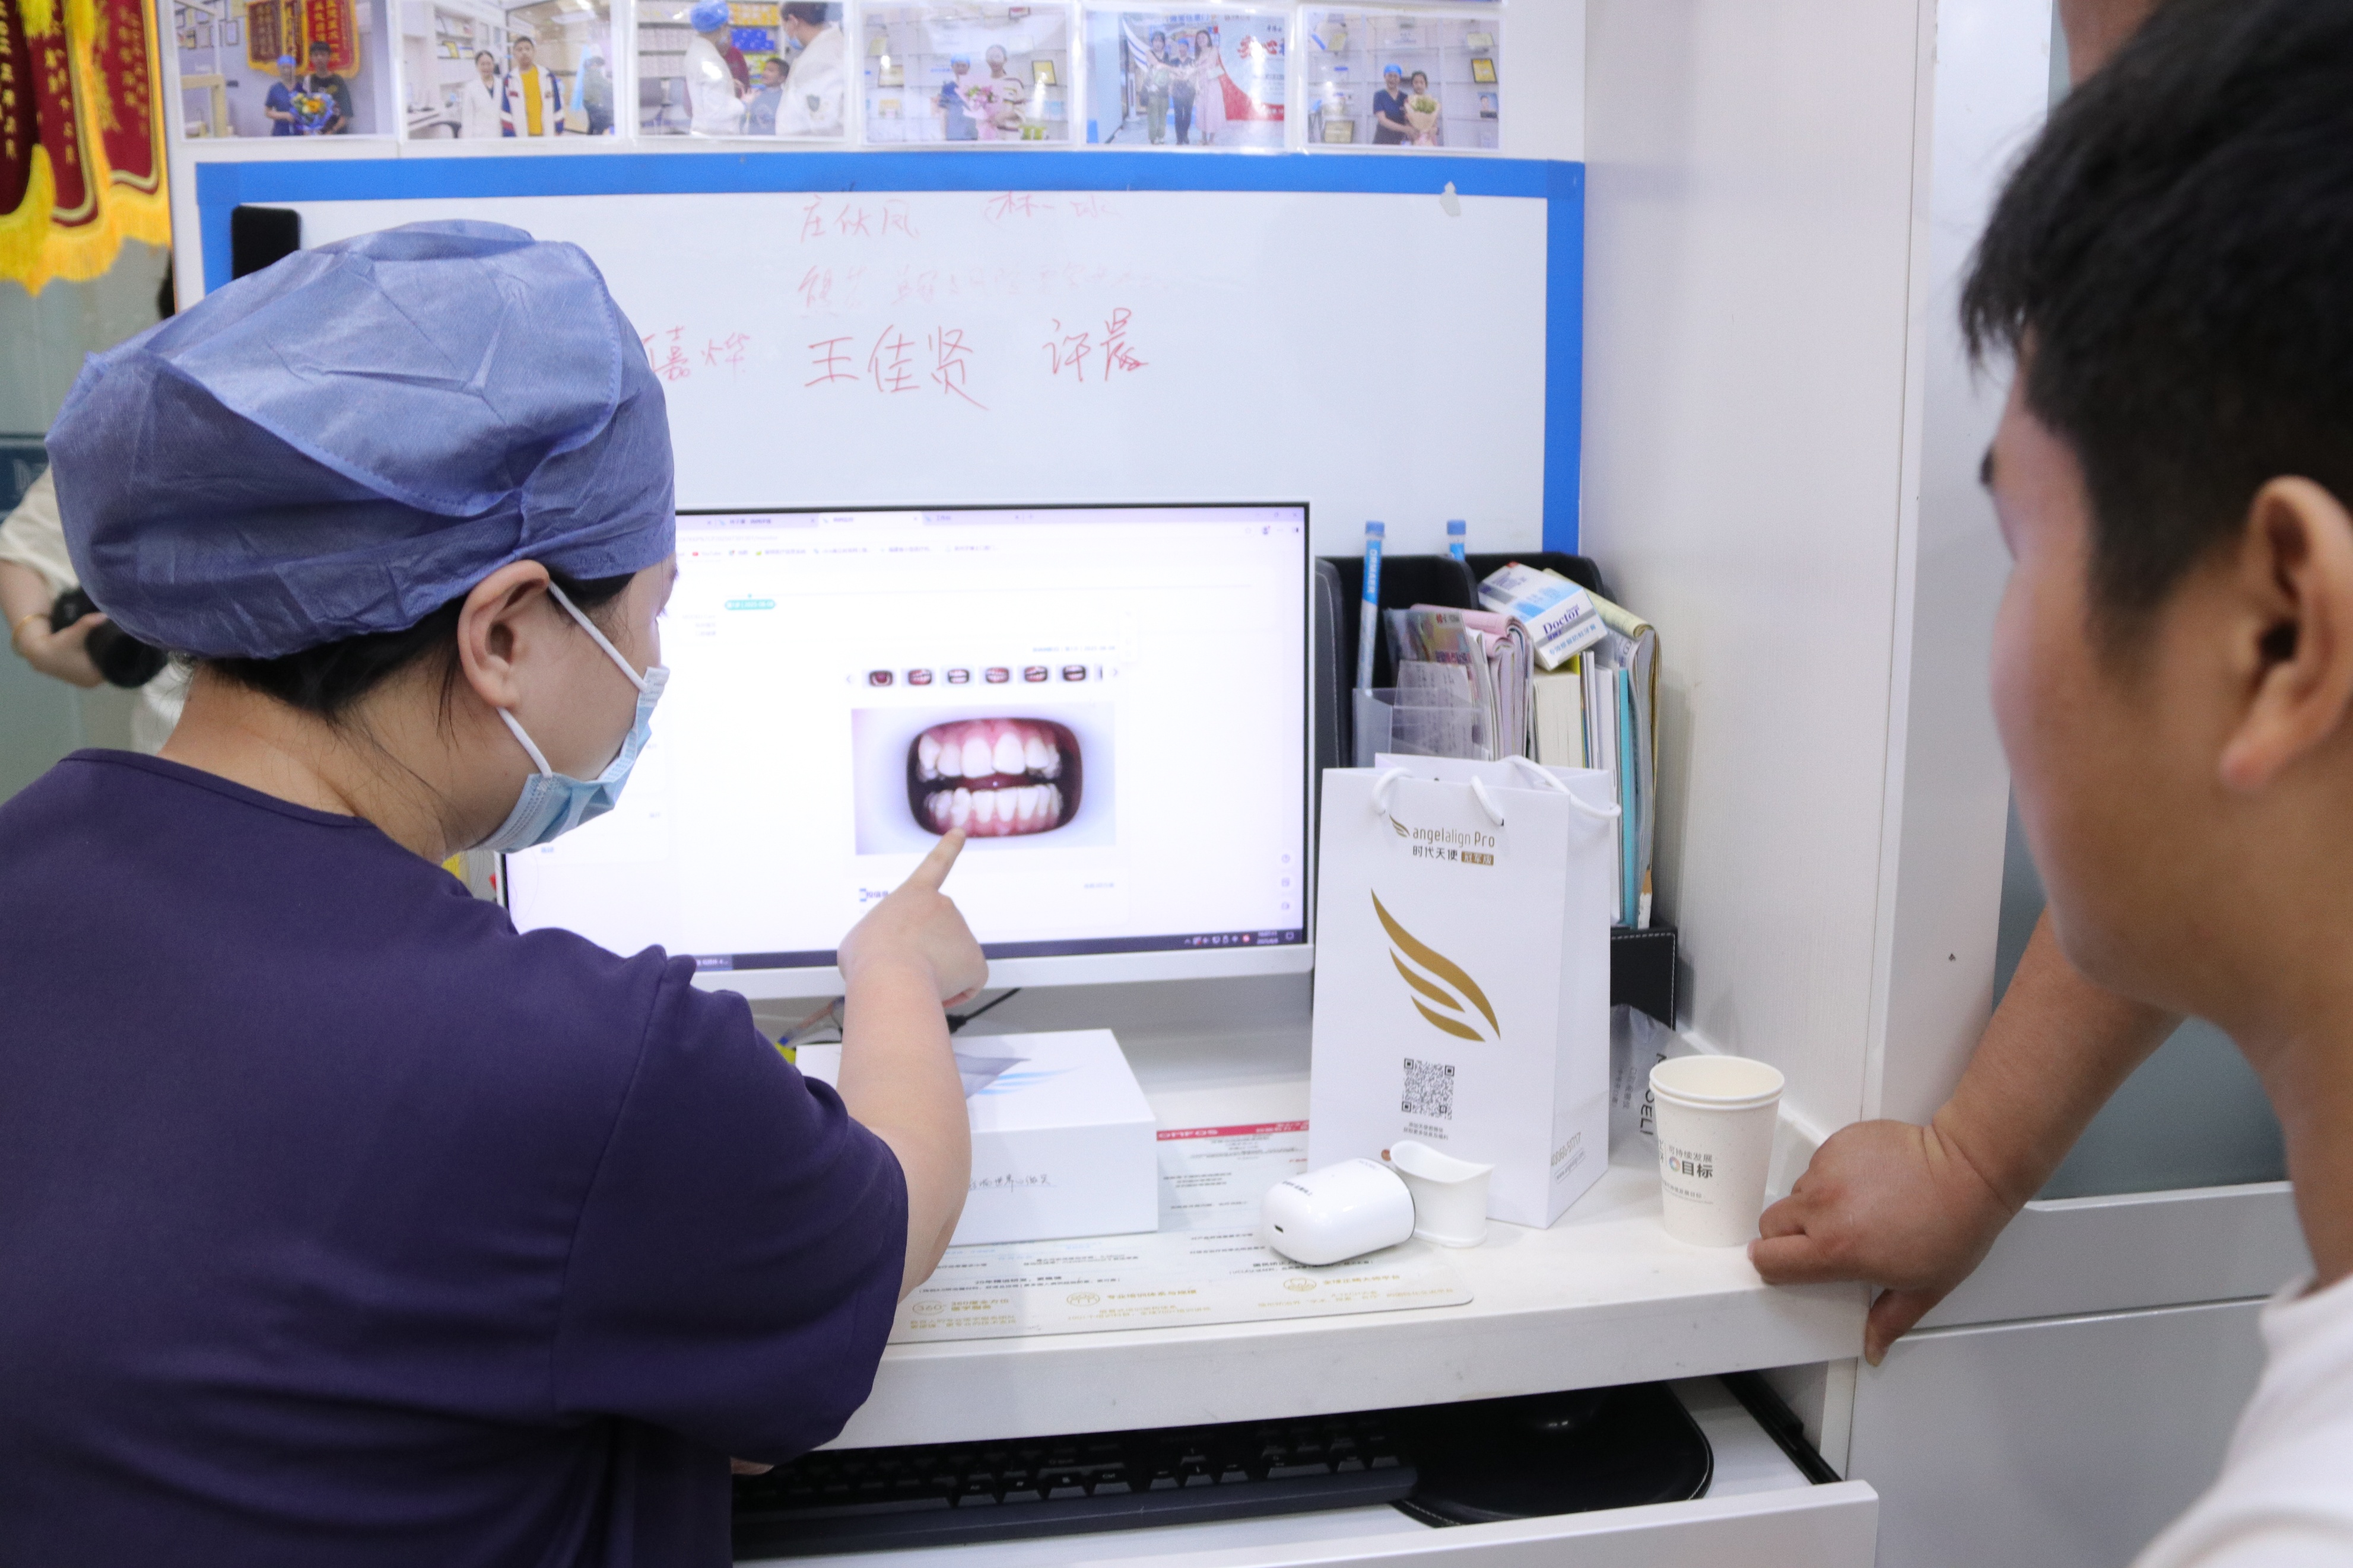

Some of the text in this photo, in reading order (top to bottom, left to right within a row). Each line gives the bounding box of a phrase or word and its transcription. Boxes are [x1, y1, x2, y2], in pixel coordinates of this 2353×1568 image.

[805, 325, 989, 411] 王佳贤
[1043, 307, 1149, 382] 许晨
[1542, 608, 1580, 635] Doctor
[1412, 828, 1495, 848] angelalign Pro
[1412, 845, 1493, 865] 时代天使 冠军版
[1668, 1144, 1712, 1163] 可持续发展
[1682, 1160, 1713, 1179] 目标
